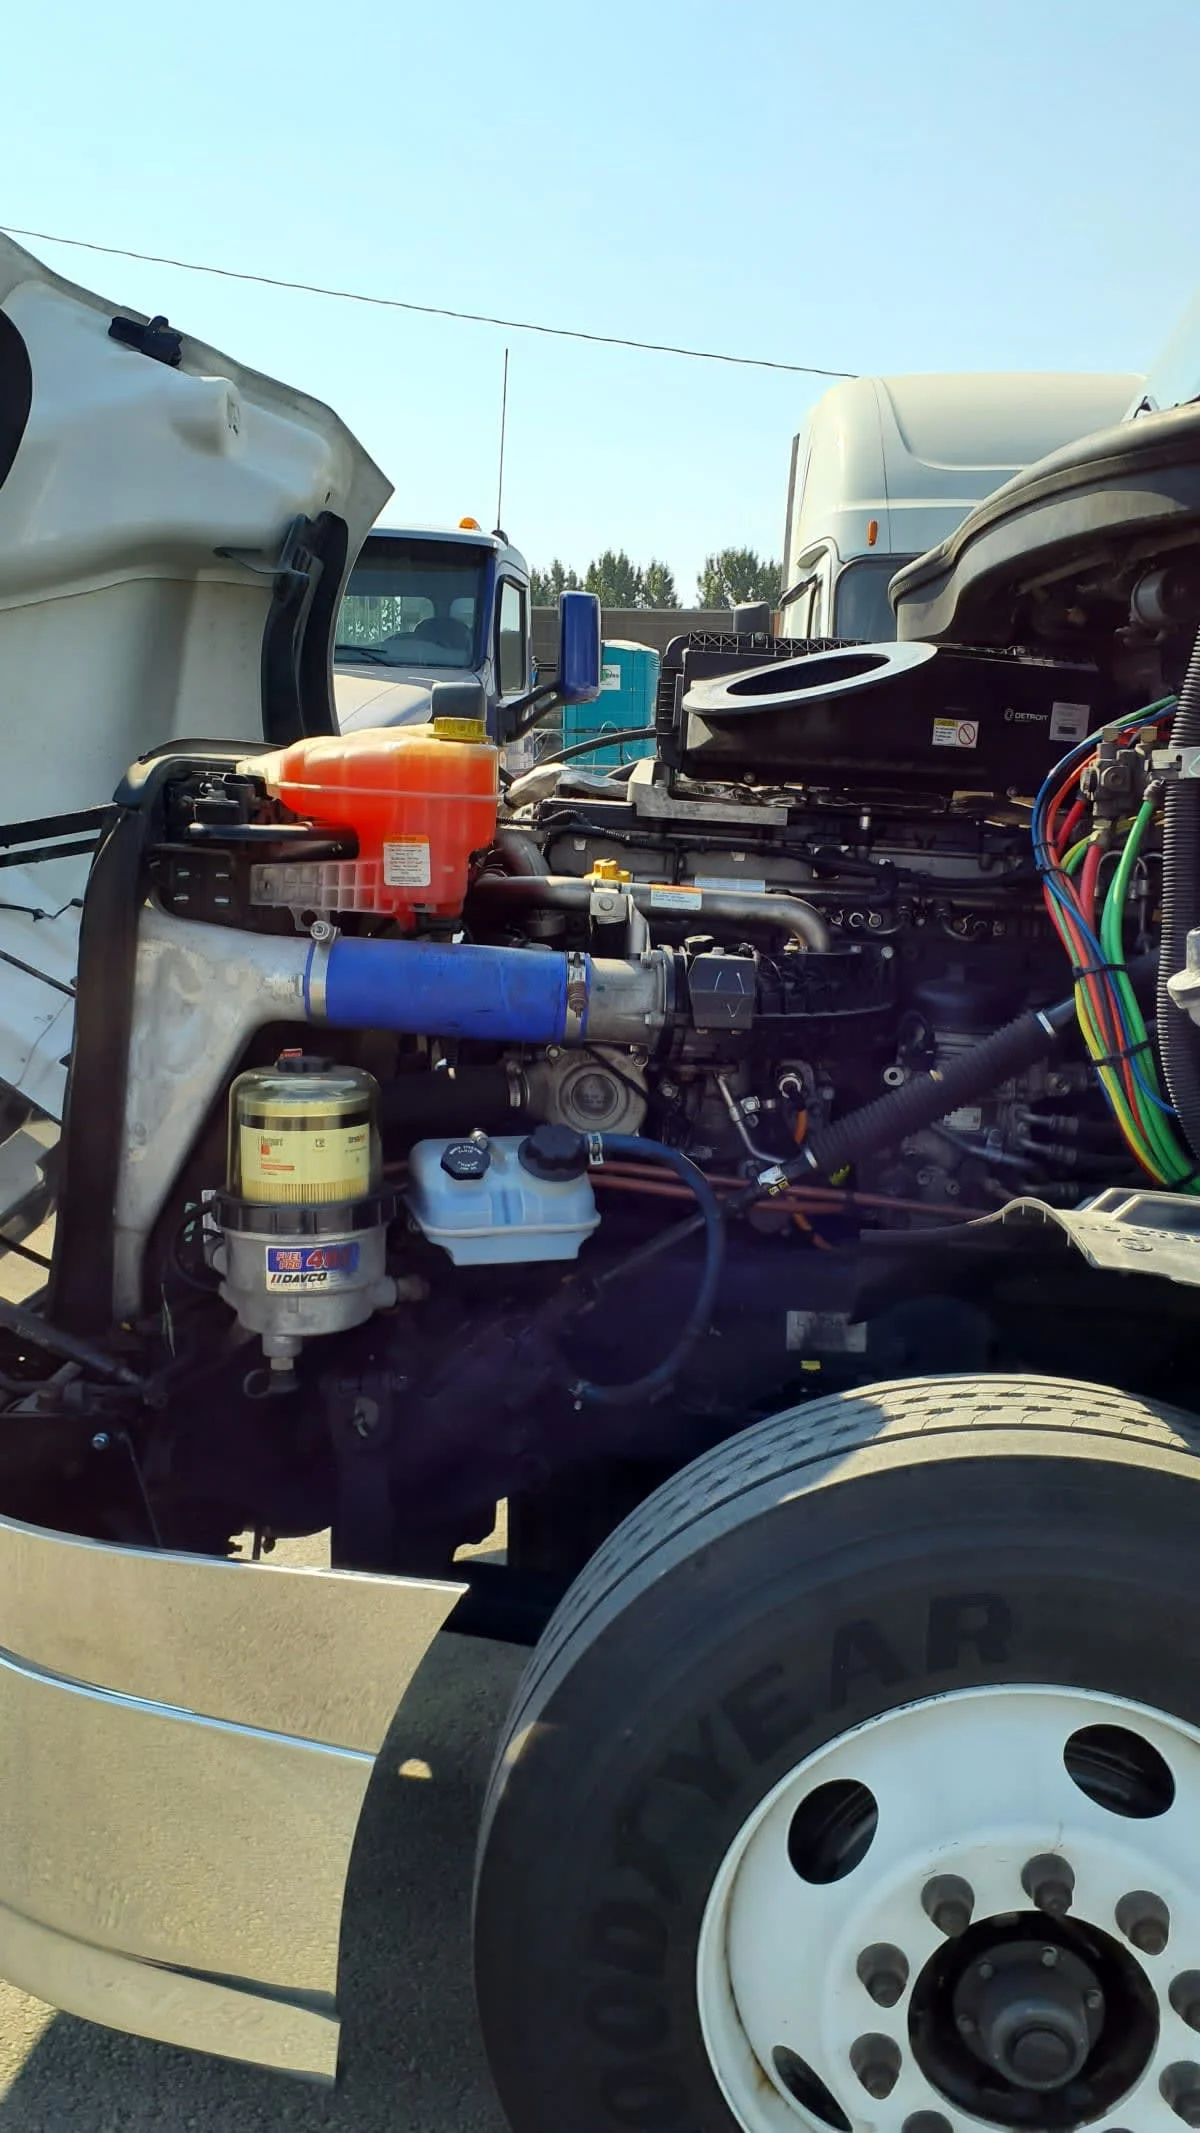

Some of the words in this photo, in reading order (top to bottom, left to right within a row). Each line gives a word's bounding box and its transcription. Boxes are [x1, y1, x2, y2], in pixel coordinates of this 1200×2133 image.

[1014, 712, 1049, 721] DETROIT
[276, 1252, 301, 1261] FUEL
[279, 1260, 302, 1270] PRO
[282, 1272, 328, 1283] DAVCO
[584, 1591, 1013, 2130] OODYEAR
